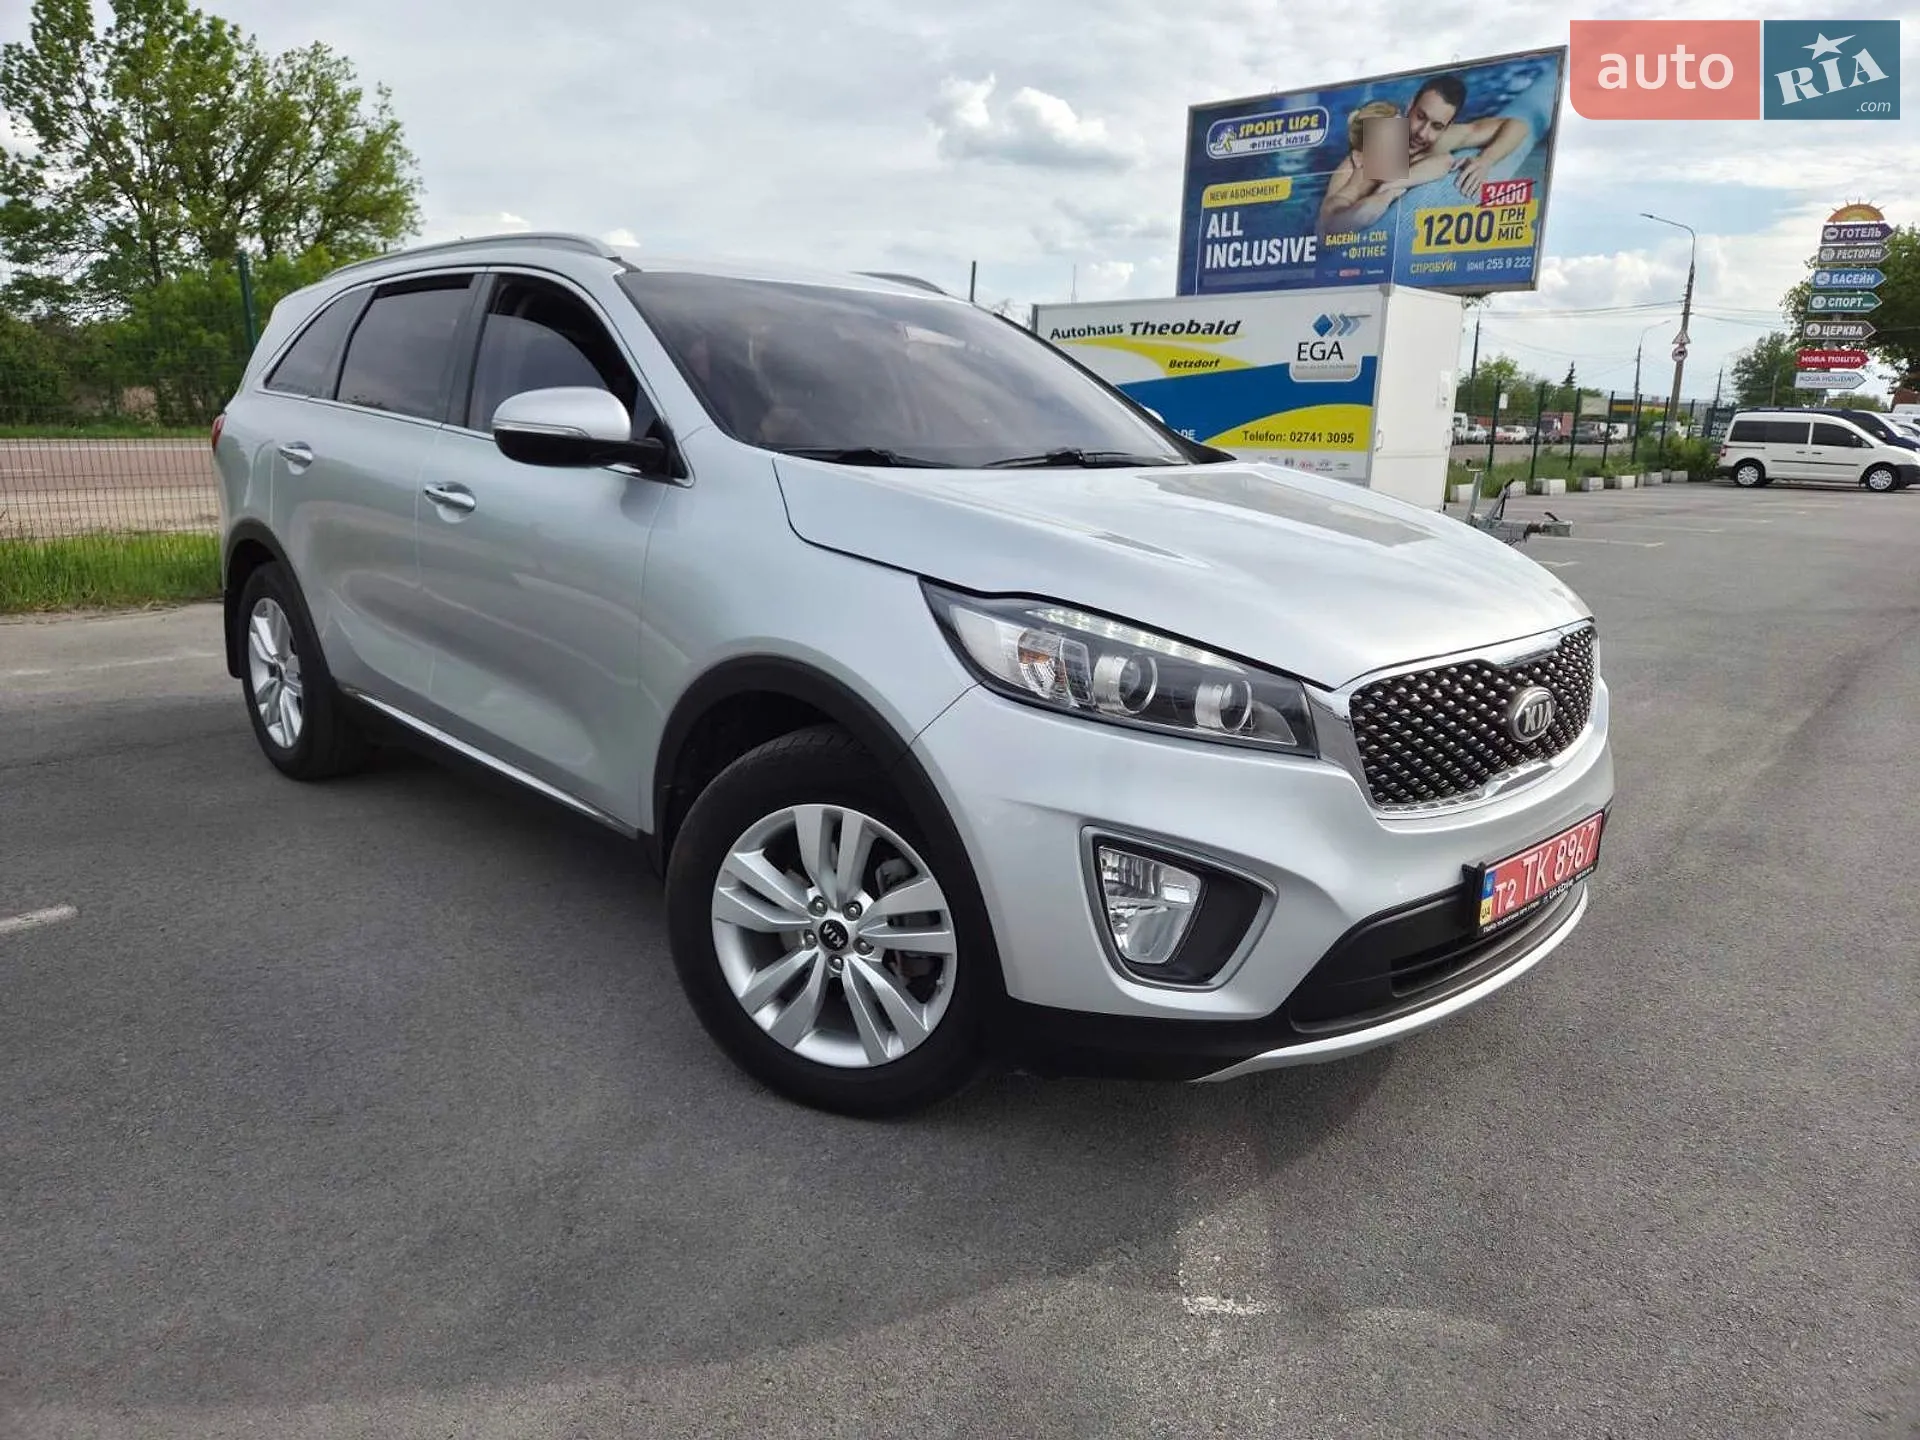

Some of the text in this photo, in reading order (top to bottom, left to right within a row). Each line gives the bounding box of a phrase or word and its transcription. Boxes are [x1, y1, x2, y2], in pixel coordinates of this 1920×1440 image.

[1239, 118, 1284, 138] SPORT
[1208, 184, 1280, 201] NEW АБОНЕМЕНТ
[1500, 207, 1527, 222] ГРН
[1206, 211, 1244, 239] ALL
[1423, 209, 1495, 247] 1200
[1840, 227, 1882, 239] ГОТЕЛЬ
[1204, 235, 1318, 269] INCLUSIVE
[1836, 248, 1883, 260] РЕСТОРАН
[1513, 255, 1532, 269] 222
[1832, 272, 1876, 285] БАСЕЙН
[1827, 297, 1864, 308] СПОРТ
[1050, 319, 1242, 340] Autohaus Theobald
[1822, 325, 1863, 337] ЦЕРКВА
[1297, 340, 1344, 361] EGA
[1168, 358, 1221, 369] Betzdorf
[1801, 355, 1861, 364] НОВА ПОШТА
[1241, 430, 1355, 444] Telefon: 02741 3095
[1494, 878, 1517, 915] T2
[1523, 846, 1553, 901] TK
[1554, 820, 1597, 881] 8967
[823, 923, 844, 948] KIA
